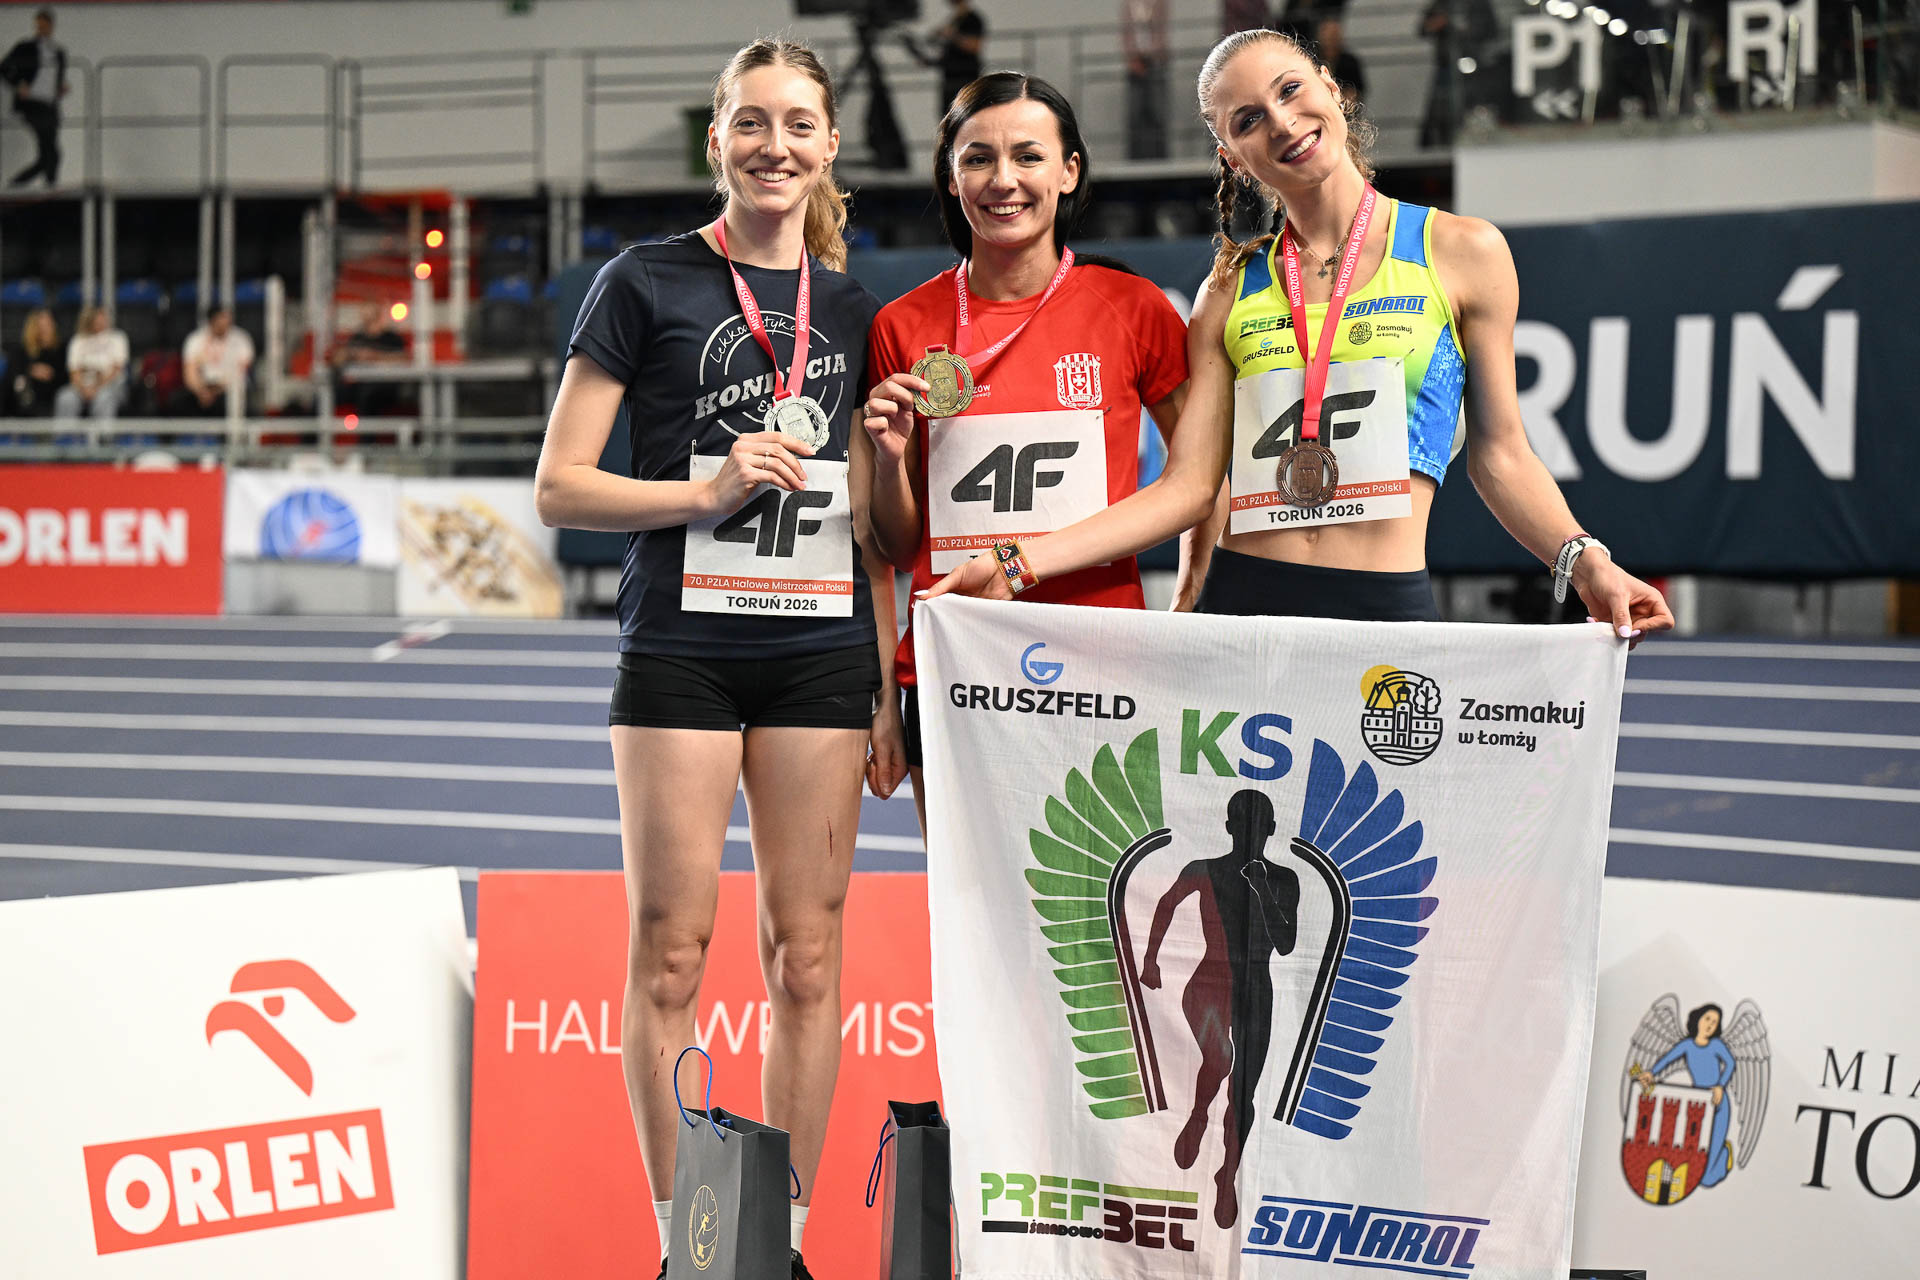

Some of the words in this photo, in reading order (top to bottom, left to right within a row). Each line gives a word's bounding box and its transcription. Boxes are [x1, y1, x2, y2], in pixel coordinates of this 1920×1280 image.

[1512, 14, 1602, 97] P1
[1727, 0, 1820, 82] R1
[1336, 241, 1361, 297] MISTRZOSTWA
[1353, 212, 1370, 240] POLSKI
[1363, 192, 1375, 212] 2026
[1288, 257, 1302, 307] MISTRZOSTWA
[1343, 297, 1425, 318] SONAROL
[1240, 313, 1294, 334] PREFBE
[1376, 325, 1412, 334] Zasmakuj
[1242, 346, 1295, 364] GRUSZFELD
[1513, 264, 1860, 483] RUŃ
[695, 353, 847, 420] KONDCJA
[1251, 390, 1376, 459] 4F
[951, 441, 1079, 512] 4F
[1236, 498, 1248, 507] 70.
[1249, 496, 1270, 506] PZLA
[1372, 482, 1402, 493] Polski
[713, 488, 834, 557] 4F
[1326, 503, 1364, 518] 2026
[936, 539, 949, 549] 70.
[951, 538, 972, 547] PZLA
[690, 576, 705, 586] 70.
[706, 577, 730, 588] PZLA
[732, 579, 770, 590] Halowe
[771, 581, 824, 592] Mistrzostwa
[825, 582, 847, 592] Polski
[726, 595, 781, 610] TORUŃ
[783, 598, 818, 611] 2026
[950, 683, 1136, 720] GRUSZFELD
[1459, 698, 1585, 730] Zasmakuj
[1180, 708, 1294, 781] KS
[1458, 731, 1475, 745] w
[1477, 730, 1537, 752] Łomży
[505, 999, 771, 1056] HALW
[1821, 1046, 1920, 1099] MI
[1794, 1103, 1920, 1200] TO
[105, 1125, 377, 1235] ORLEN
[1245, 1200, 1484, 1272] SONAROL
